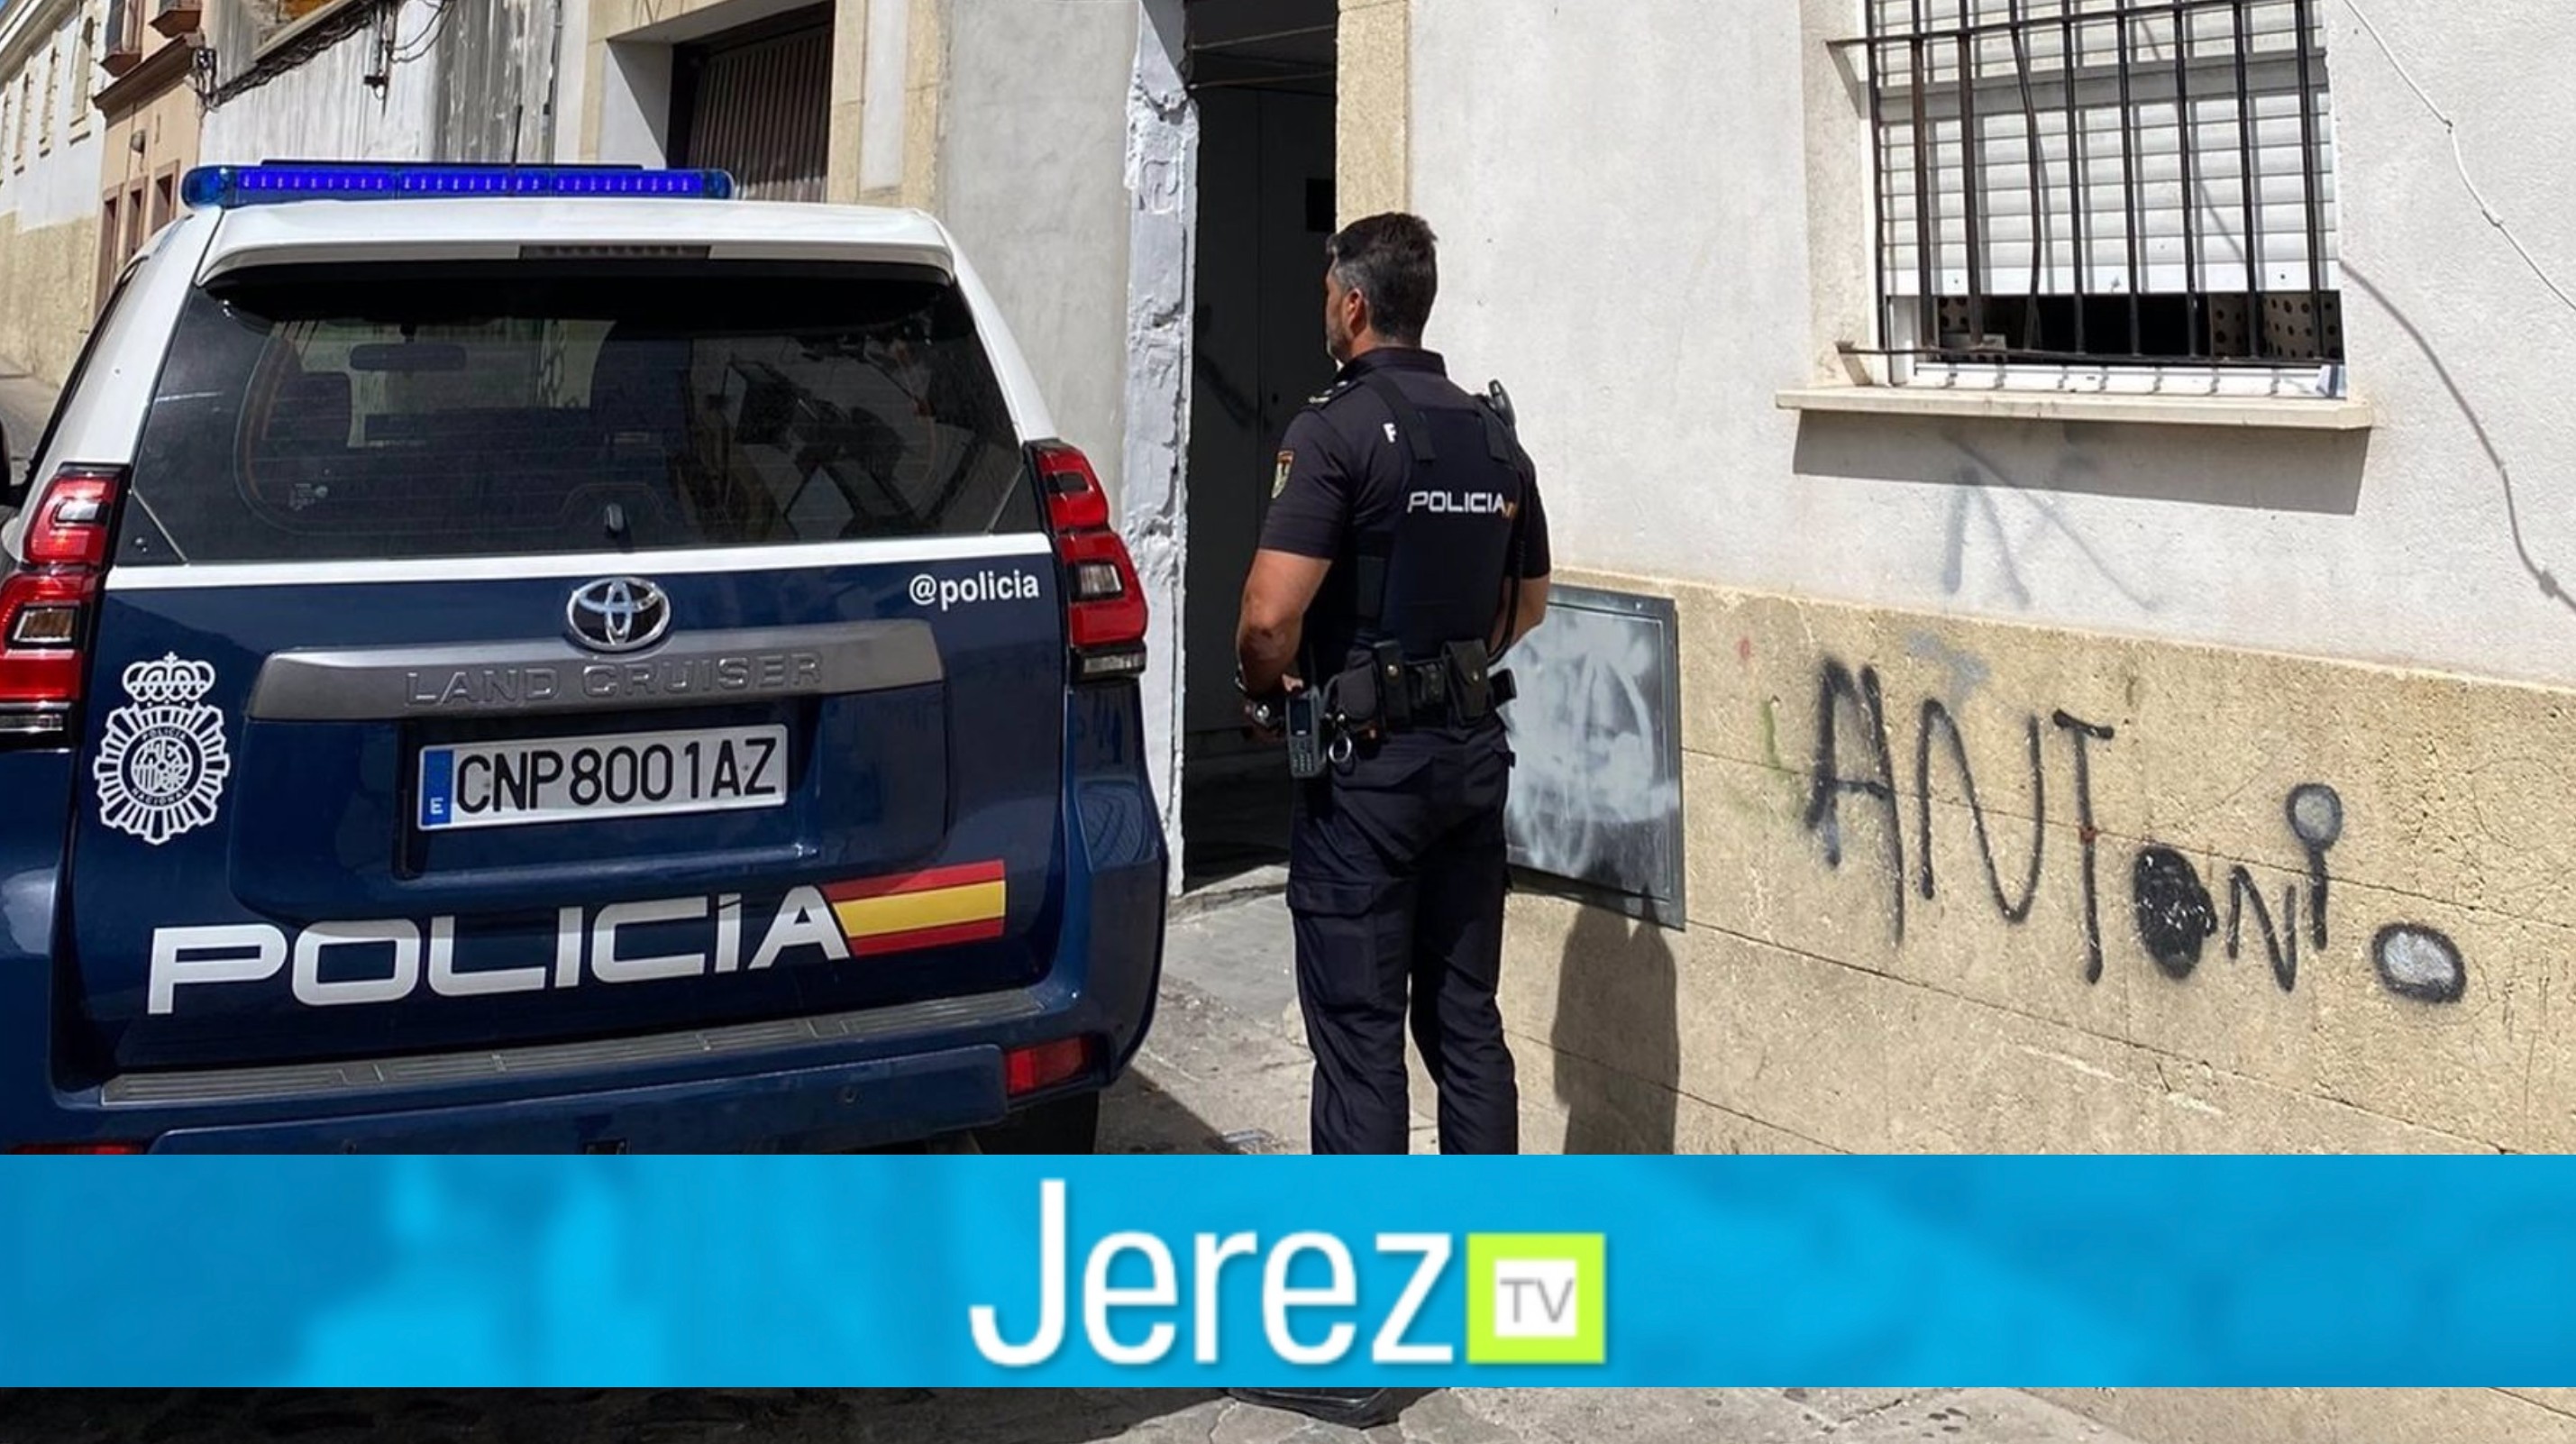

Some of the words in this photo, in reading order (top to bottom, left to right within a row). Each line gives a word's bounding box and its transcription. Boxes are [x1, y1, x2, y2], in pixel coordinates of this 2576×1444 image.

[909, 570, 1039, 611] @policia
[405, 667, 561, 708] LAND
[581, 651, 823, 701] CRUISER
[456, 736, 778, 815] CNP8001AZ
[428, 797, 444, 815] E
